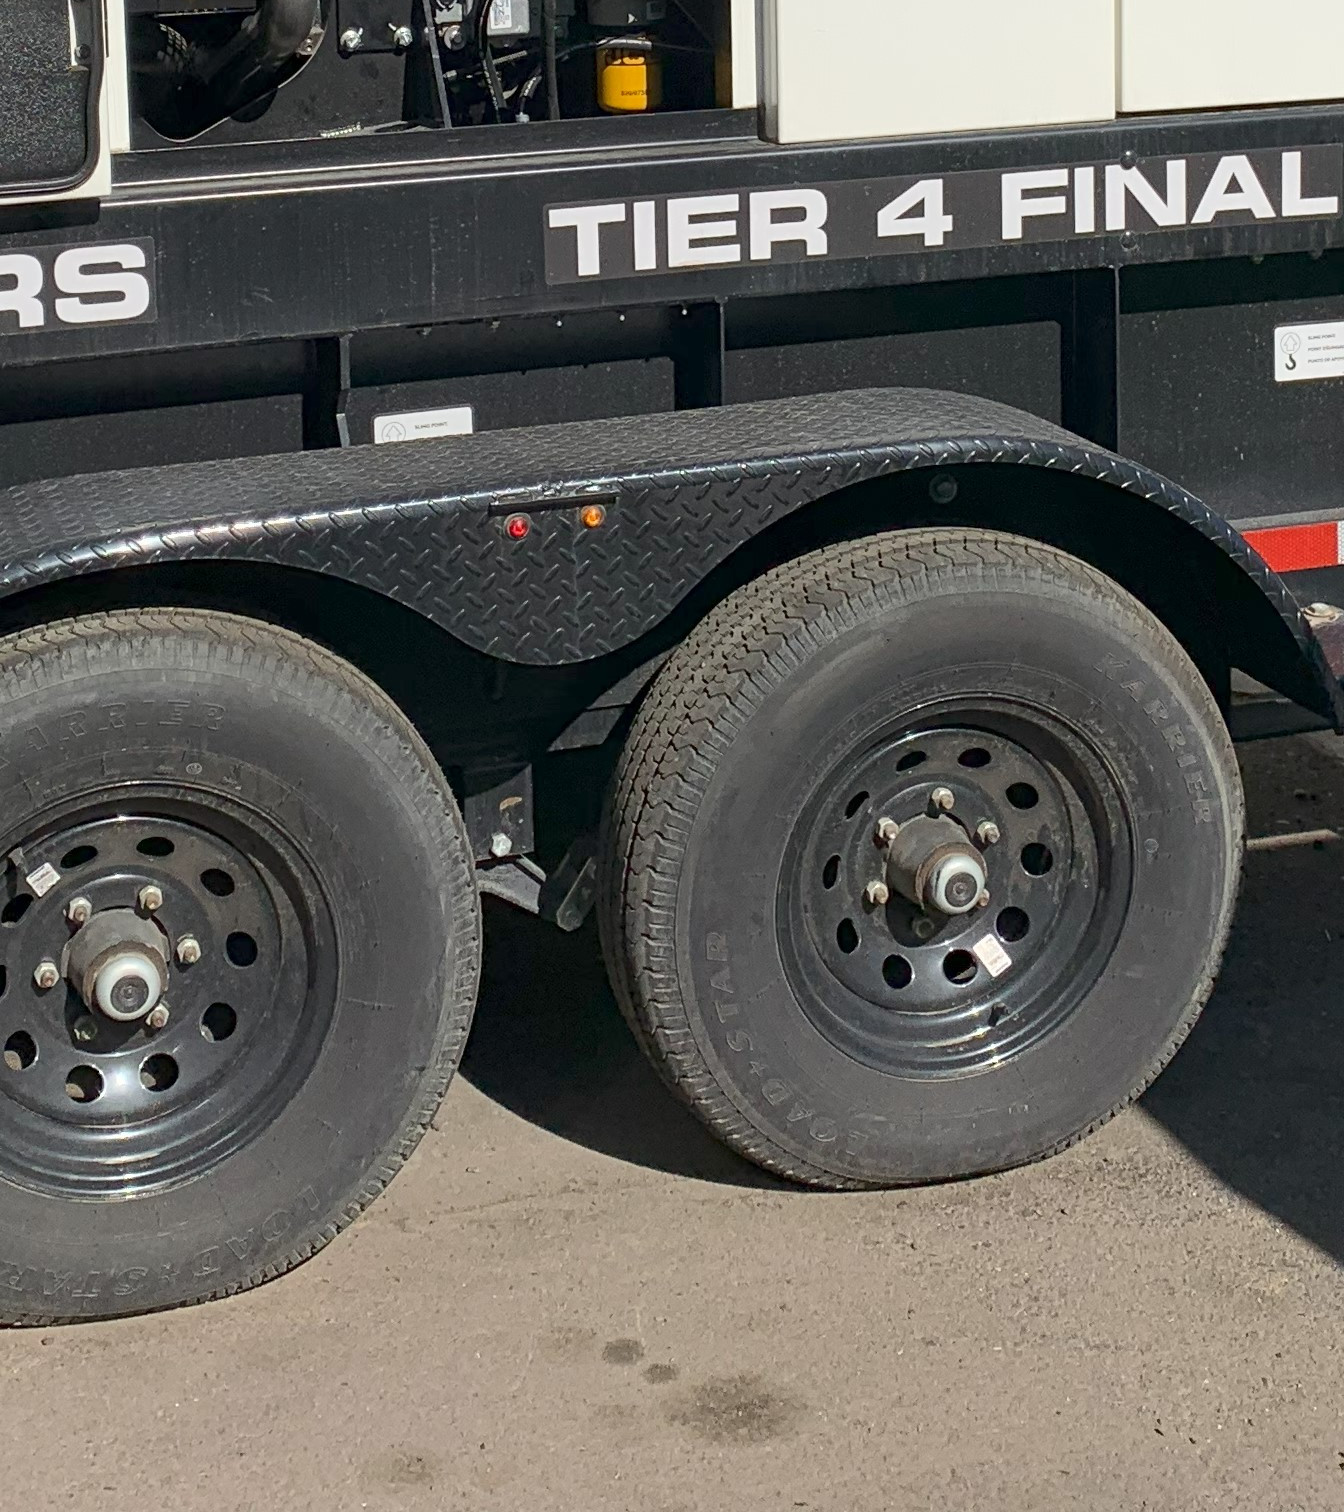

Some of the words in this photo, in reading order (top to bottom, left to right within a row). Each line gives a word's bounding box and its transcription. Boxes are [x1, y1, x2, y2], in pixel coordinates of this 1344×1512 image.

[548, 187, 829, 277] TIER
[876, 179, 953, 247] 4
[1001, 151, 1339, 240] FINAL
[1092, 653, 1214, 825] KARRIER
